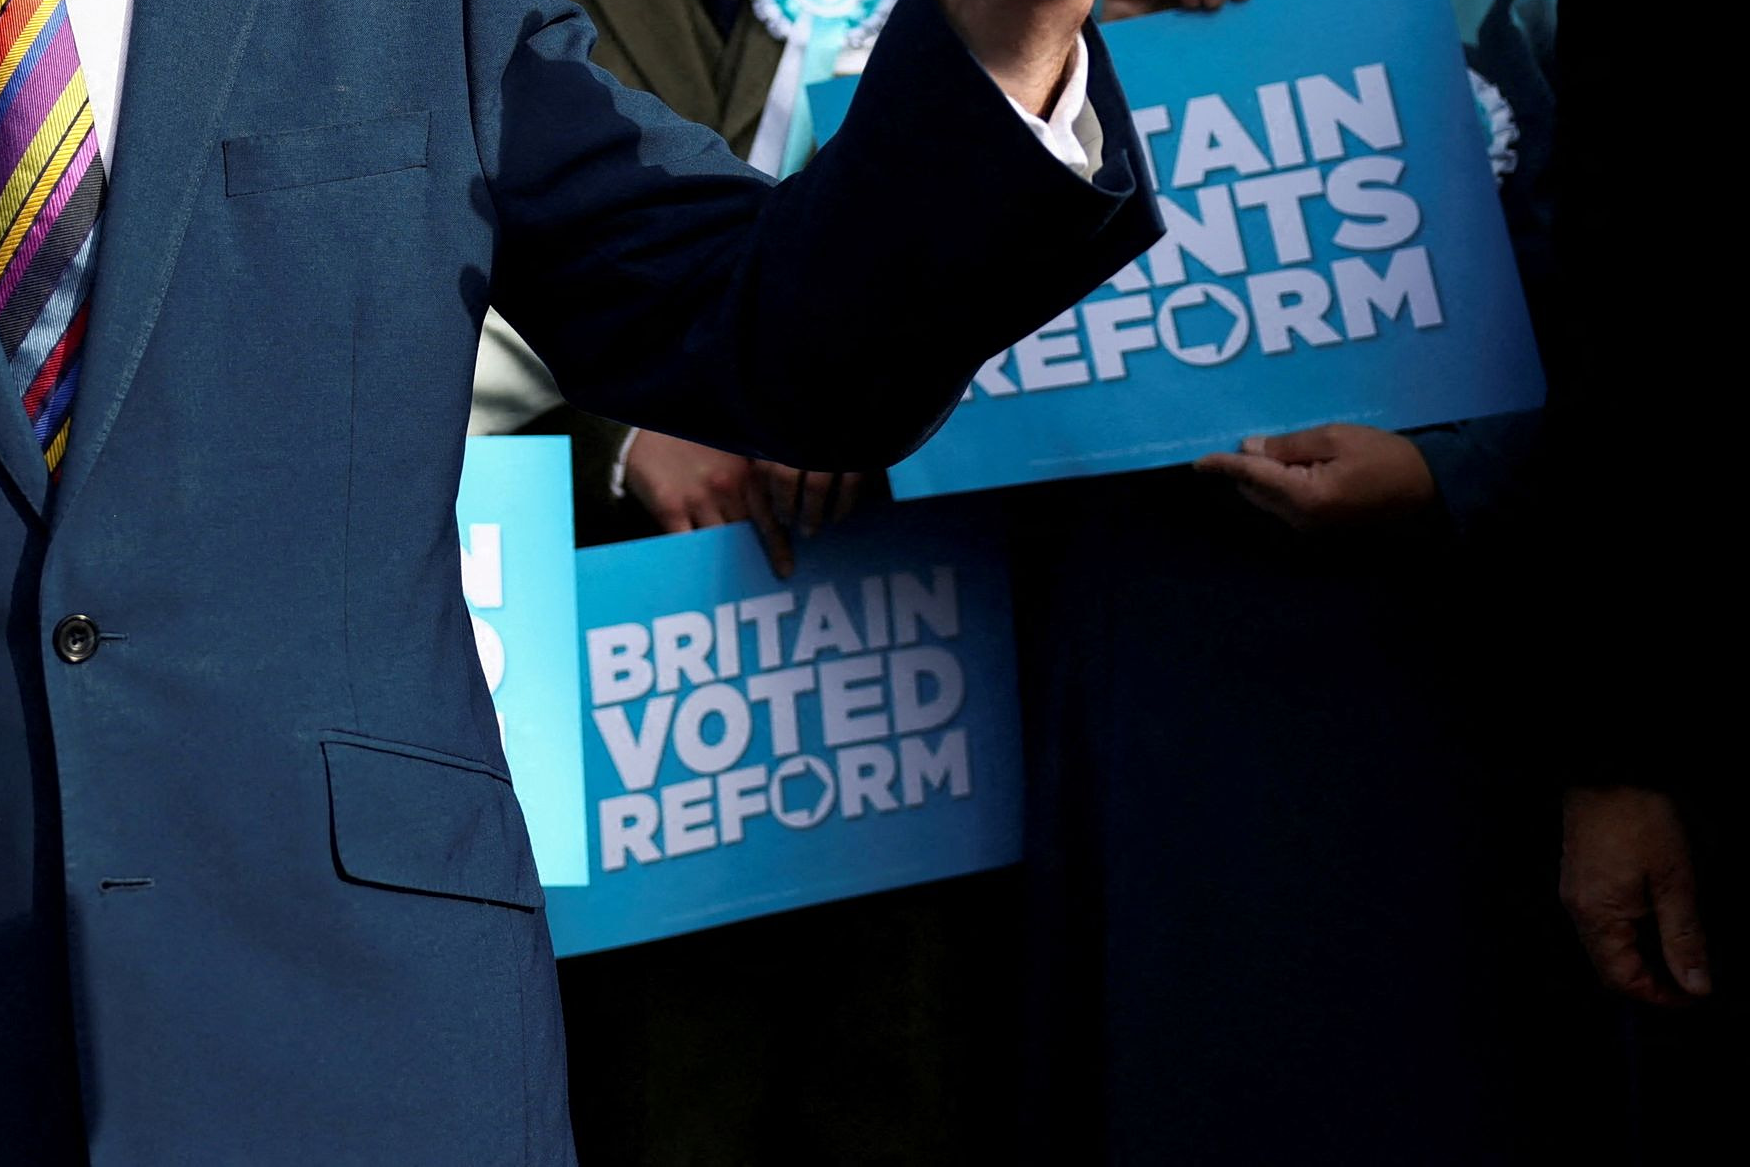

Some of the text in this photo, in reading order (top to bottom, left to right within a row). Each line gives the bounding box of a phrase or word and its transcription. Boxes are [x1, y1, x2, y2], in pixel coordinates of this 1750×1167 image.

[586, 565, 962, 707] BRITAIN
[591, 643, 966, 792] VOTED
[598, 728, 971, 872] REFORM
